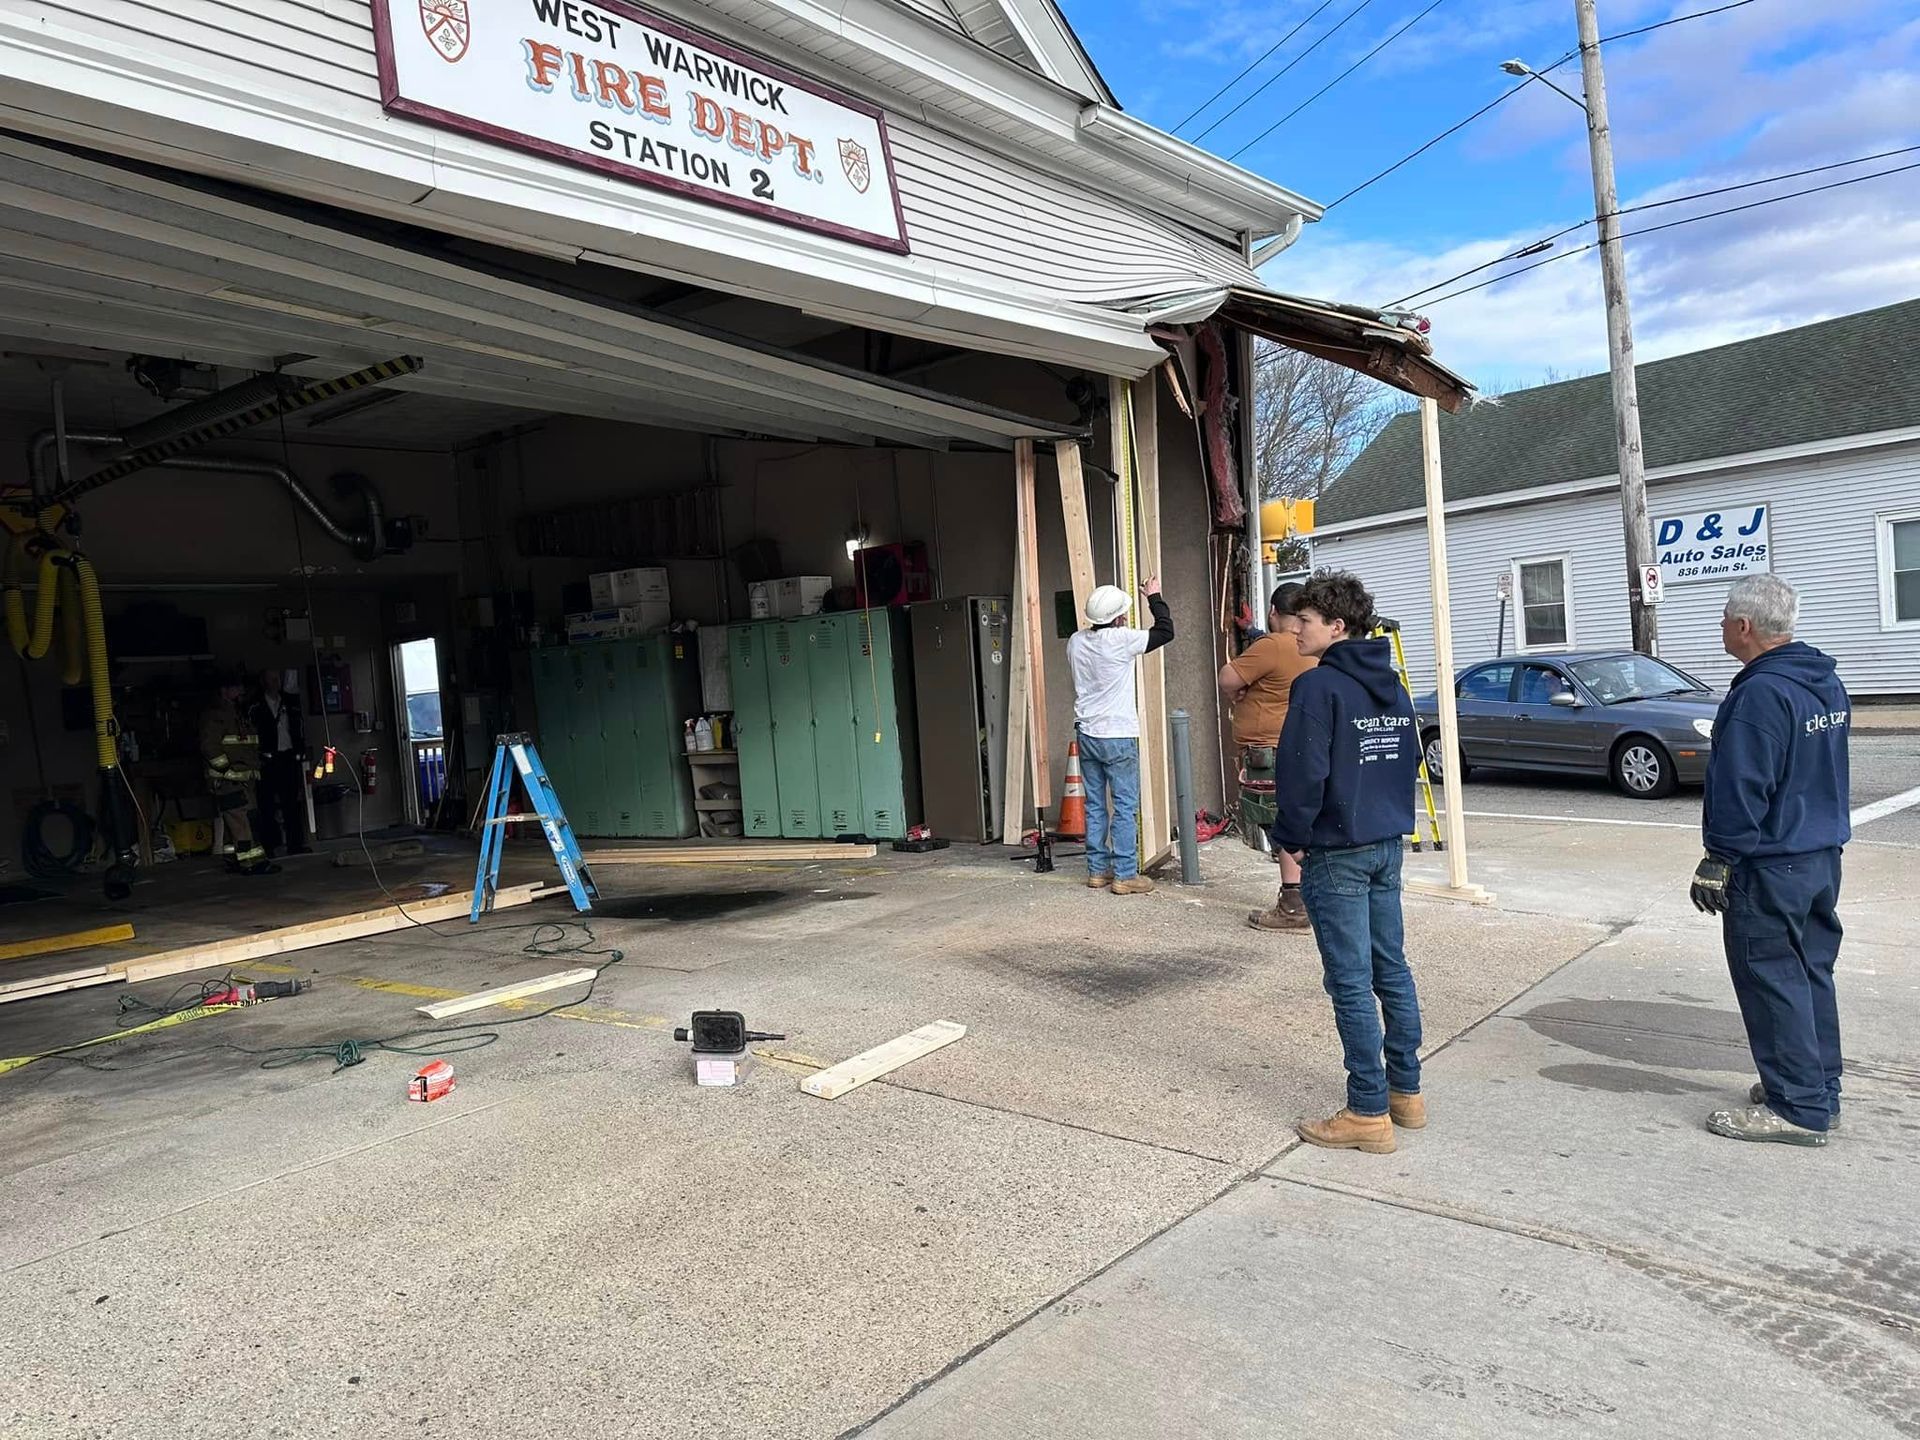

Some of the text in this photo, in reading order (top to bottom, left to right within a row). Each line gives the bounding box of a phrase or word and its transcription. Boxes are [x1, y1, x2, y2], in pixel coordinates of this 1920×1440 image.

[533, 0, 788, 115] WEST WARWICK
[522, 38, 824, 184] FIRE DEPT.
[589, 120, 775, 200] STATION 2
[1657, 507, 1765, 546] D & J
[1660, 543, 1766, 565] Auto Sales
[1750, 554, 1766, 562] LLC
[1678, 562, 1748, 577] 836 Main St.
[1384, 716, 1410, 727] care
